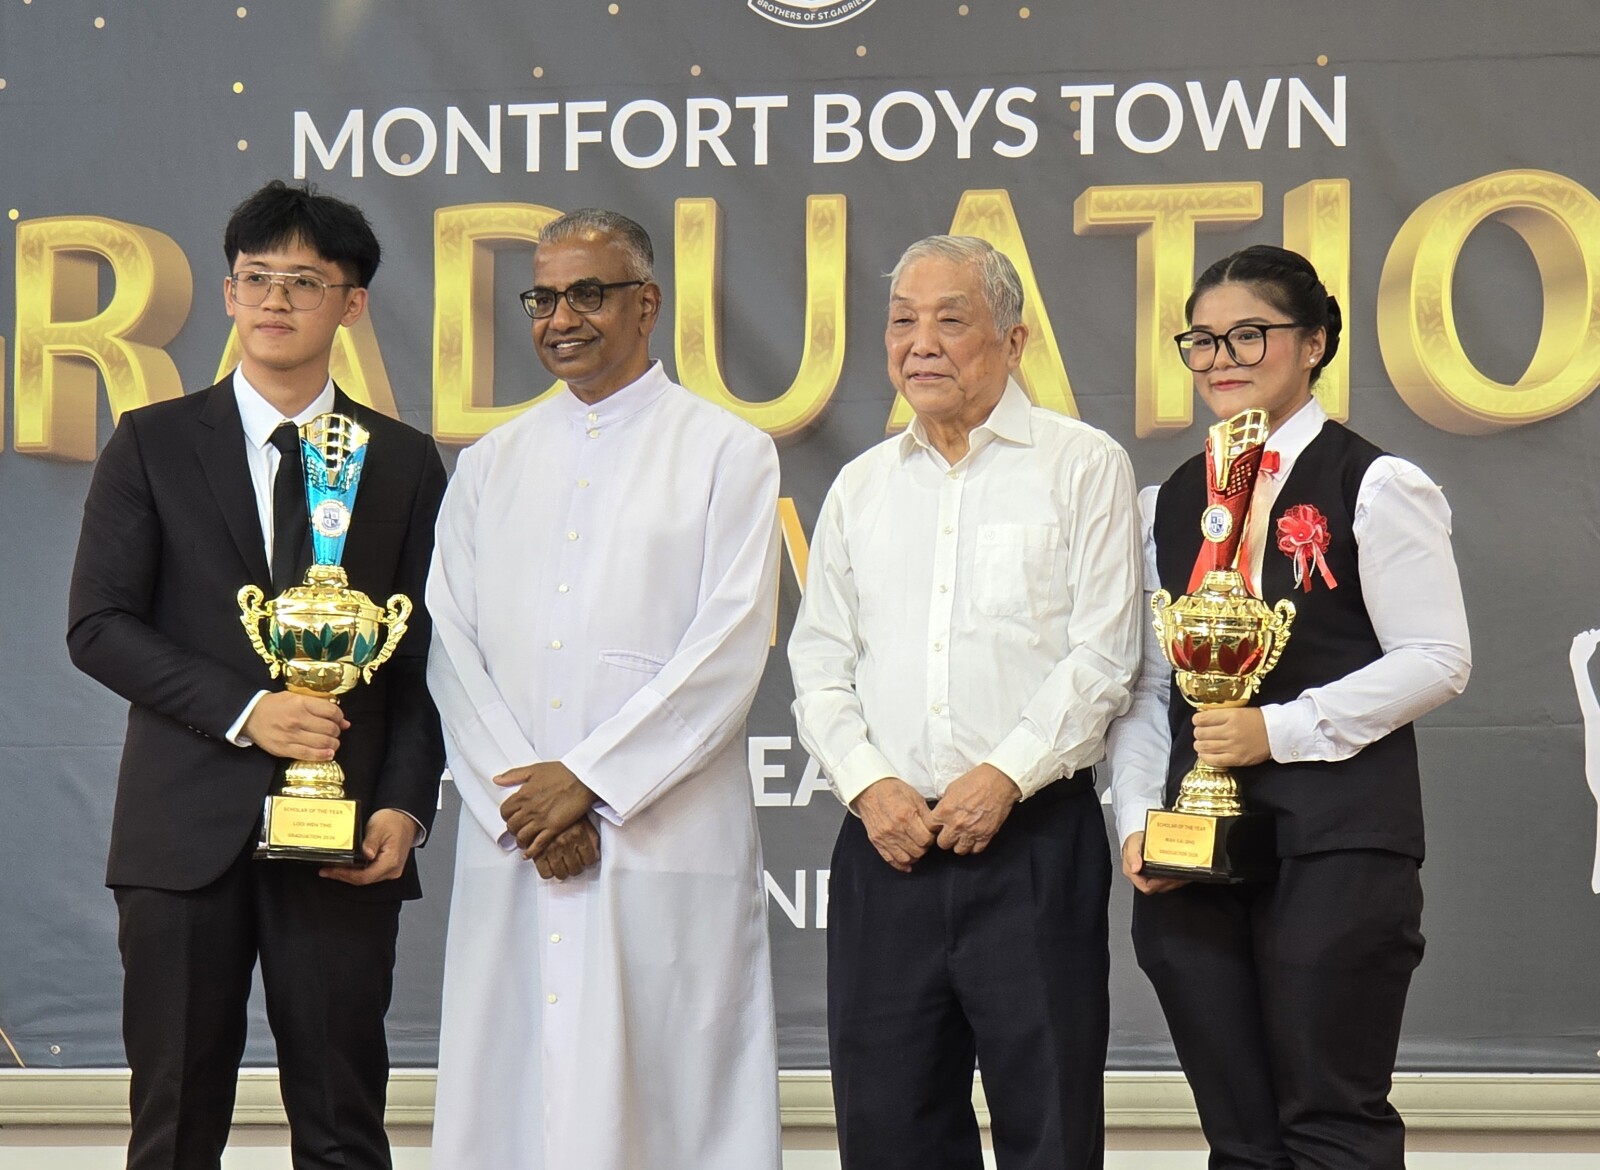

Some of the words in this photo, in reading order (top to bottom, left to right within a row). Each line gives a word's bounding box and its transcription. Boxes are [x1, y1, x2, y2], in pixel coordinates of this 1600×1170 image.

[757, 0, 802, 20] BROTHERS
[803, 13, 816, 21] OF
[294, 94, 789, 180] MONTFORT
[813, 86, 1039, 165] BOYS
[1060, 75, 1348, 155] TOWN
[0, 168, 1600, 462] RDUATIO
